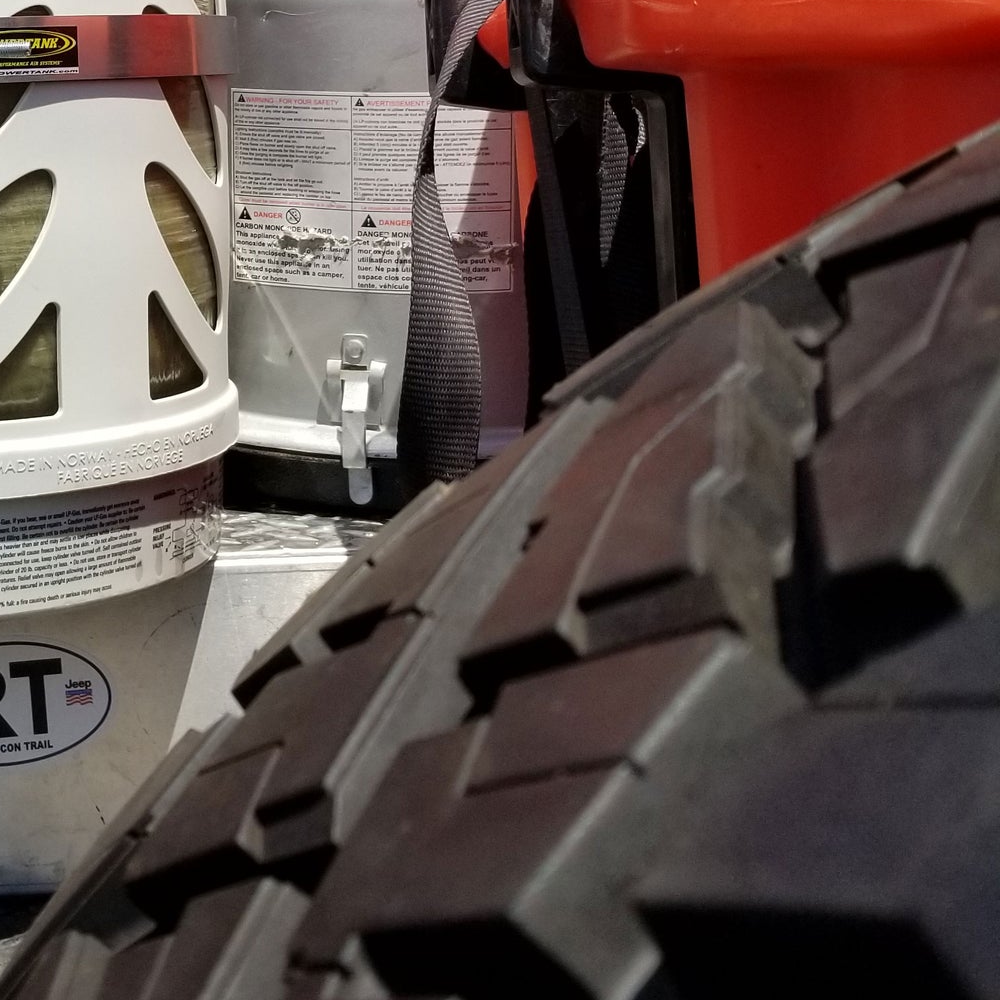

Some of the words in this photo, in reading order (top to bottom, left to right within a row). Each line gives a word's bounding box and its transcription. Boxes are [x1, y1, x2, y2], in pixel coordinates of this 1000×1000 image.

[253, 211, 282, 219] DANGER
[236, 222, 263, 230] CARBON
[39, 456, 52, 471] IN
[57, 448, 112, 469] NORWAY
[65, 679, 92, 690] Jeep
[24, 740, 53, 751] TRAIL
